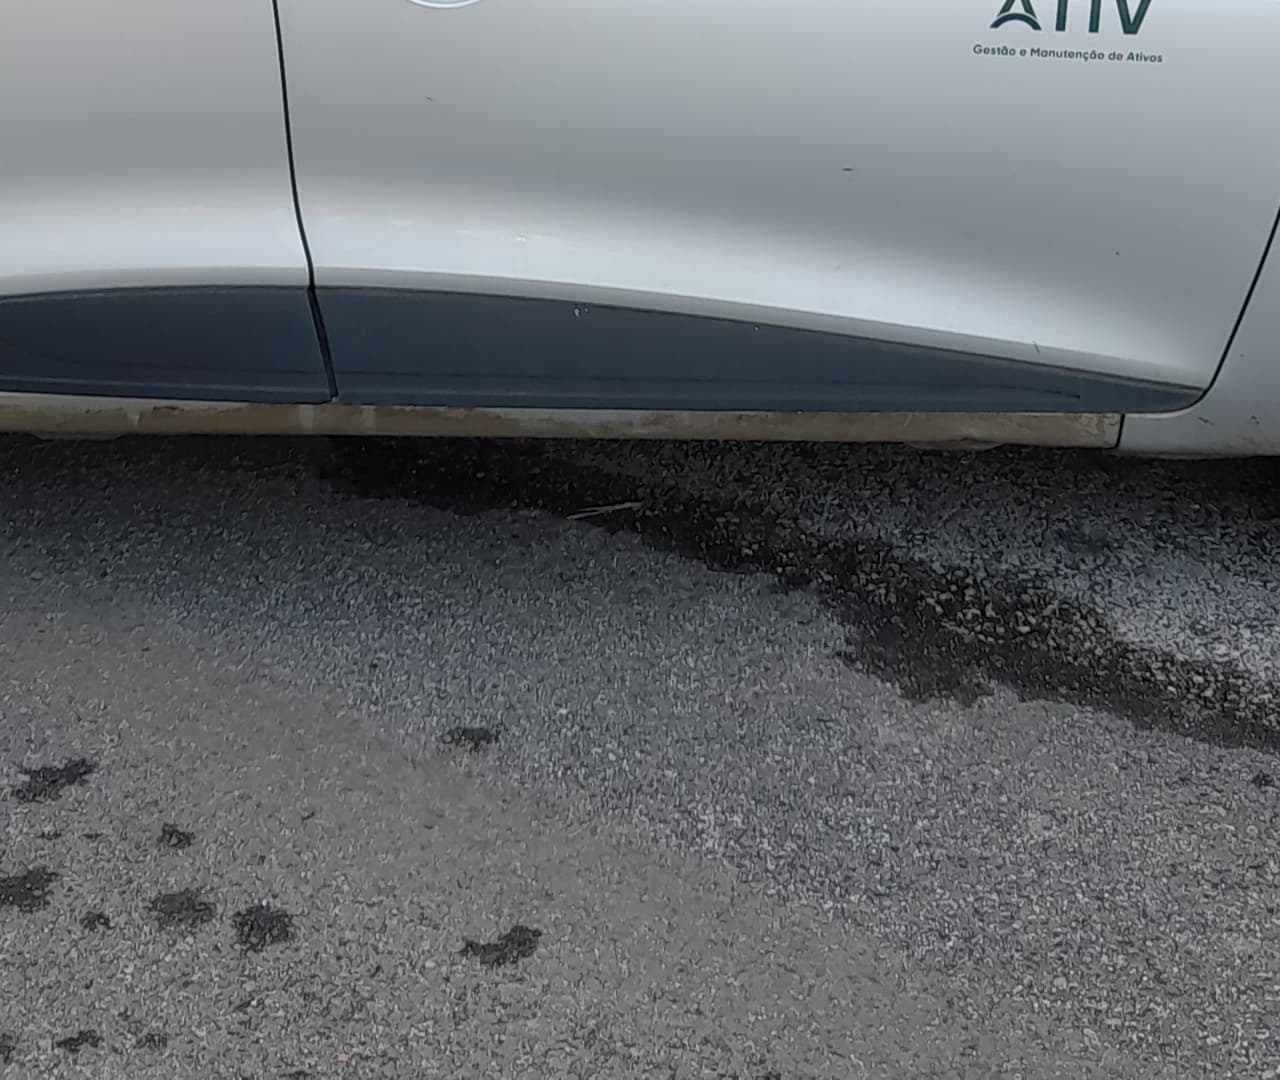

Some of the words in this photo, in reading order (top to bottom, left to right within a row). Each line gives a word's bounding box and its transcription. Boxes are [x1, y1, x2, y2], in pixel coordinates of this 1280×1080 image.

[972, 44, 1017, 57] Gestão
[1019, 47, 1027, 57] e
[1030, 47, 1105, 62] Manutenção
[1107, 51, 1124, 61] de
[1126, 51, 1164, 63] Ativos
